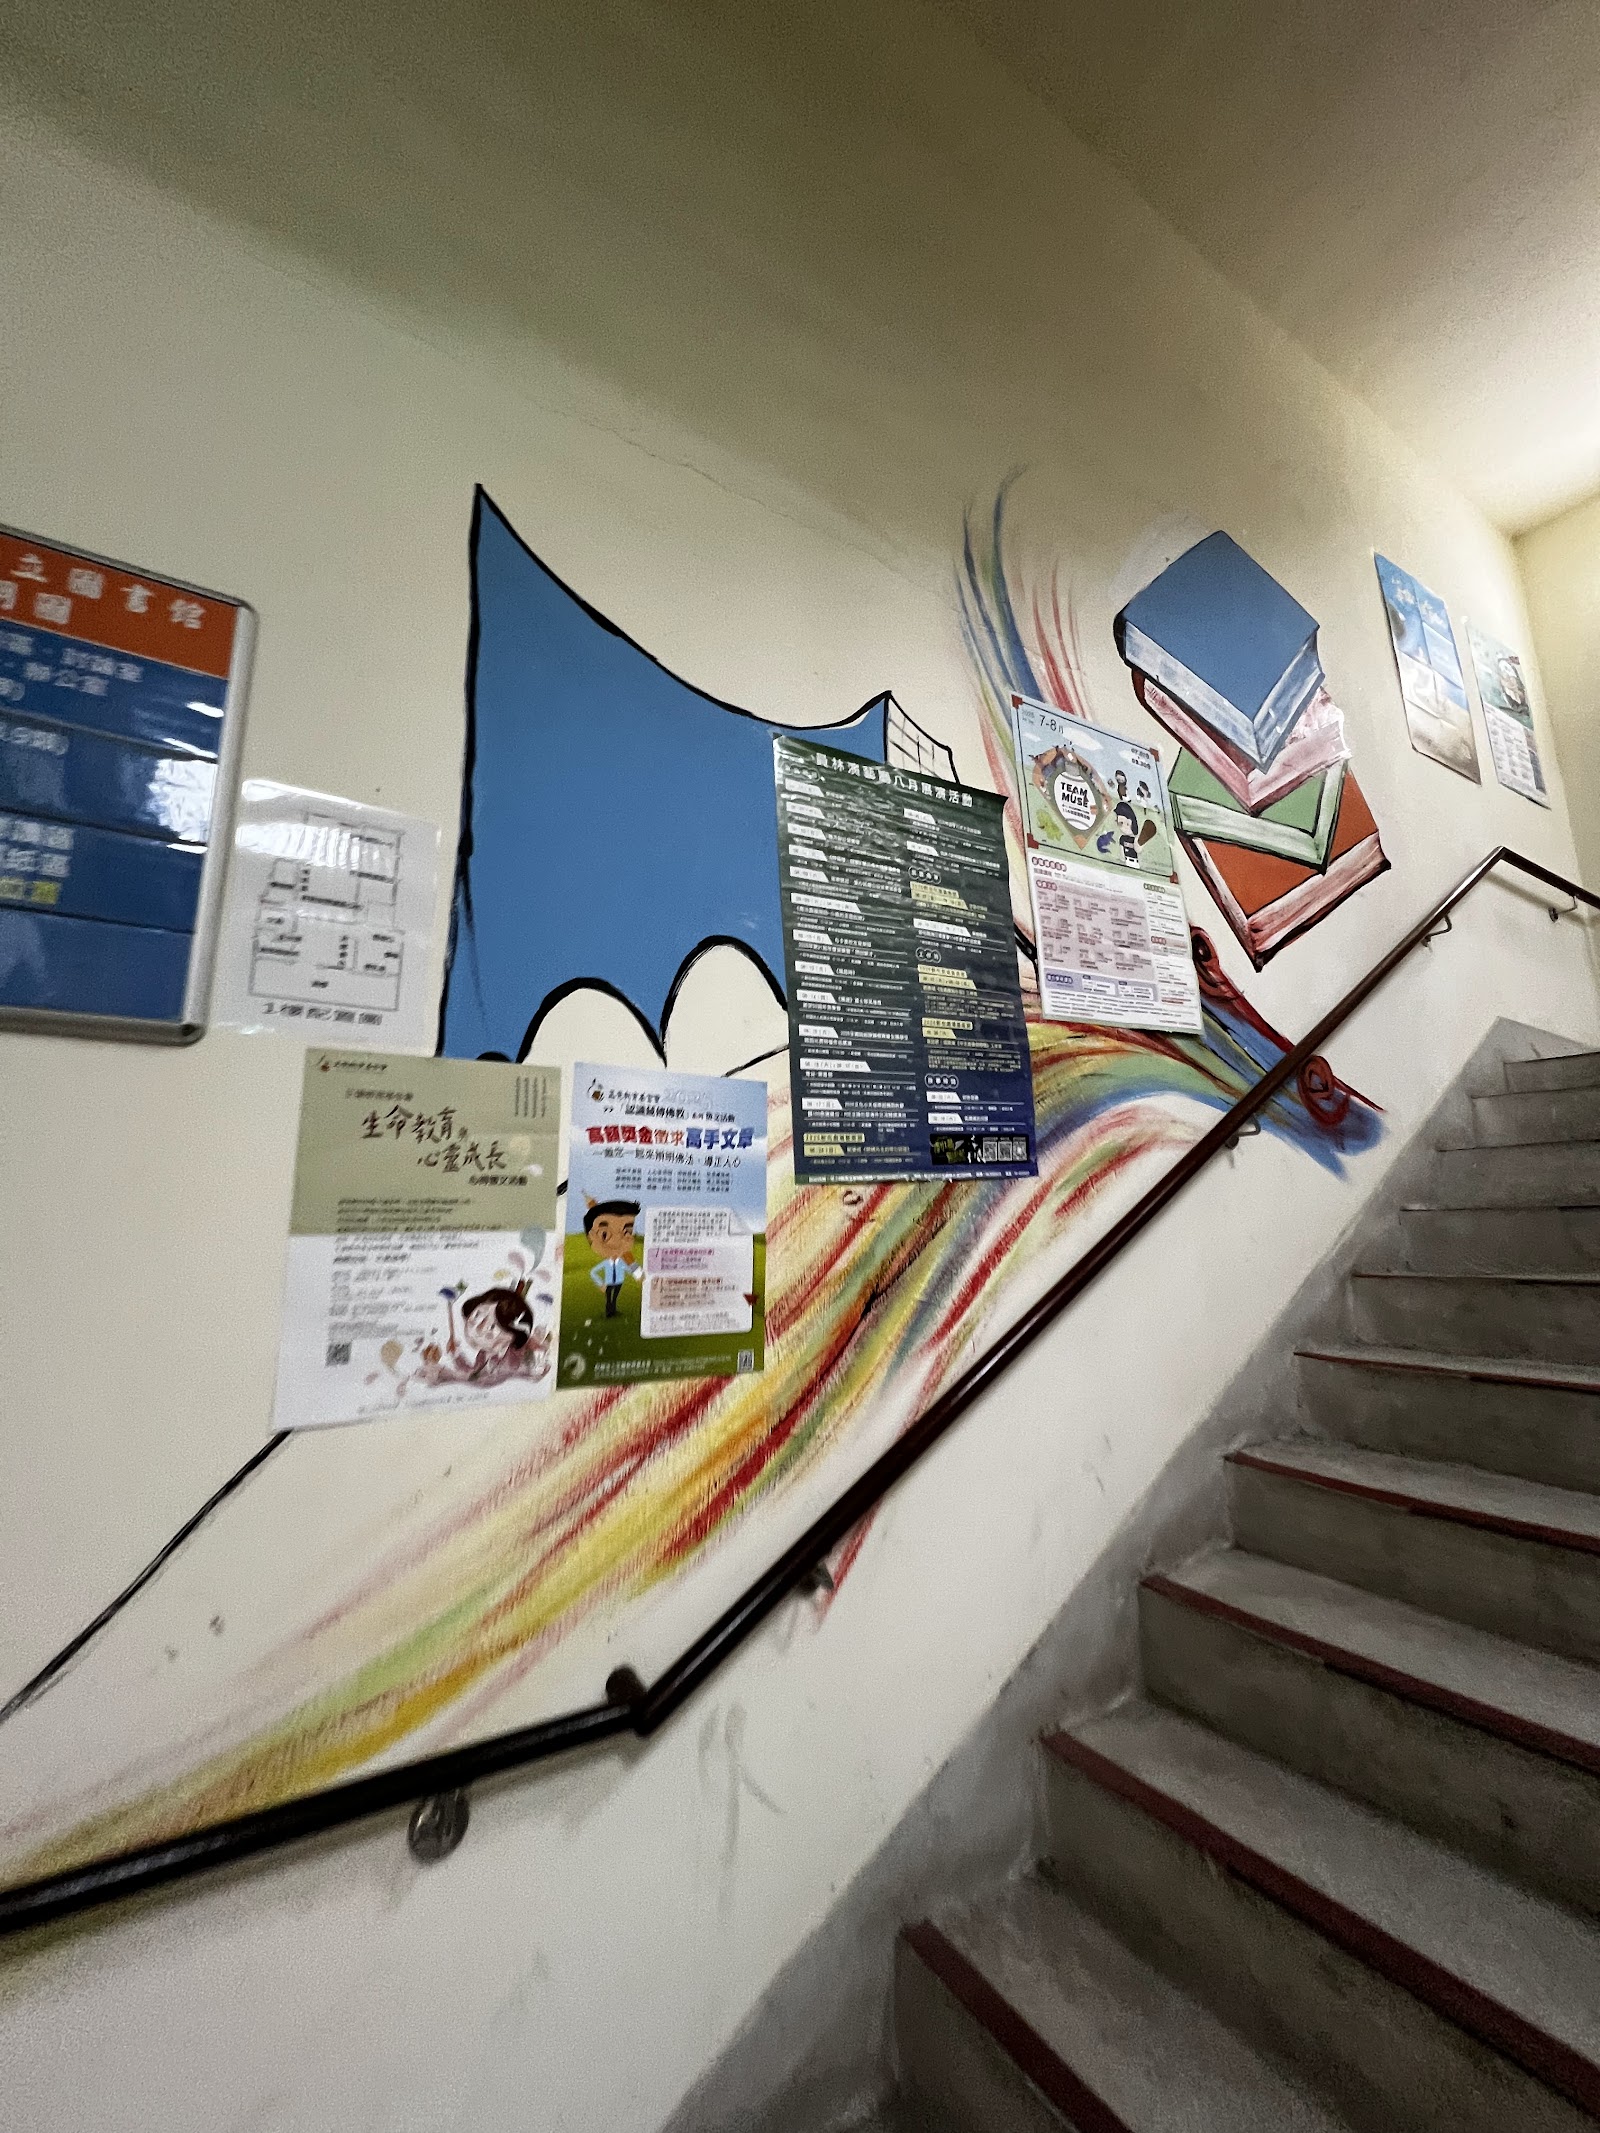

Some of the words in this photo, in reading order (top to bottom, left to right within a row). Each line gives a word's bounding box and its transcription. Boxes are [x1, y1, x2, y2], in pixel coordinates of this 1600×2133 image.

[1060, 781, 1088, 796] TEAM
[1061, 792, 1090, 808] MUSE
[416, 1139, 507, 1174] 心靈成長
